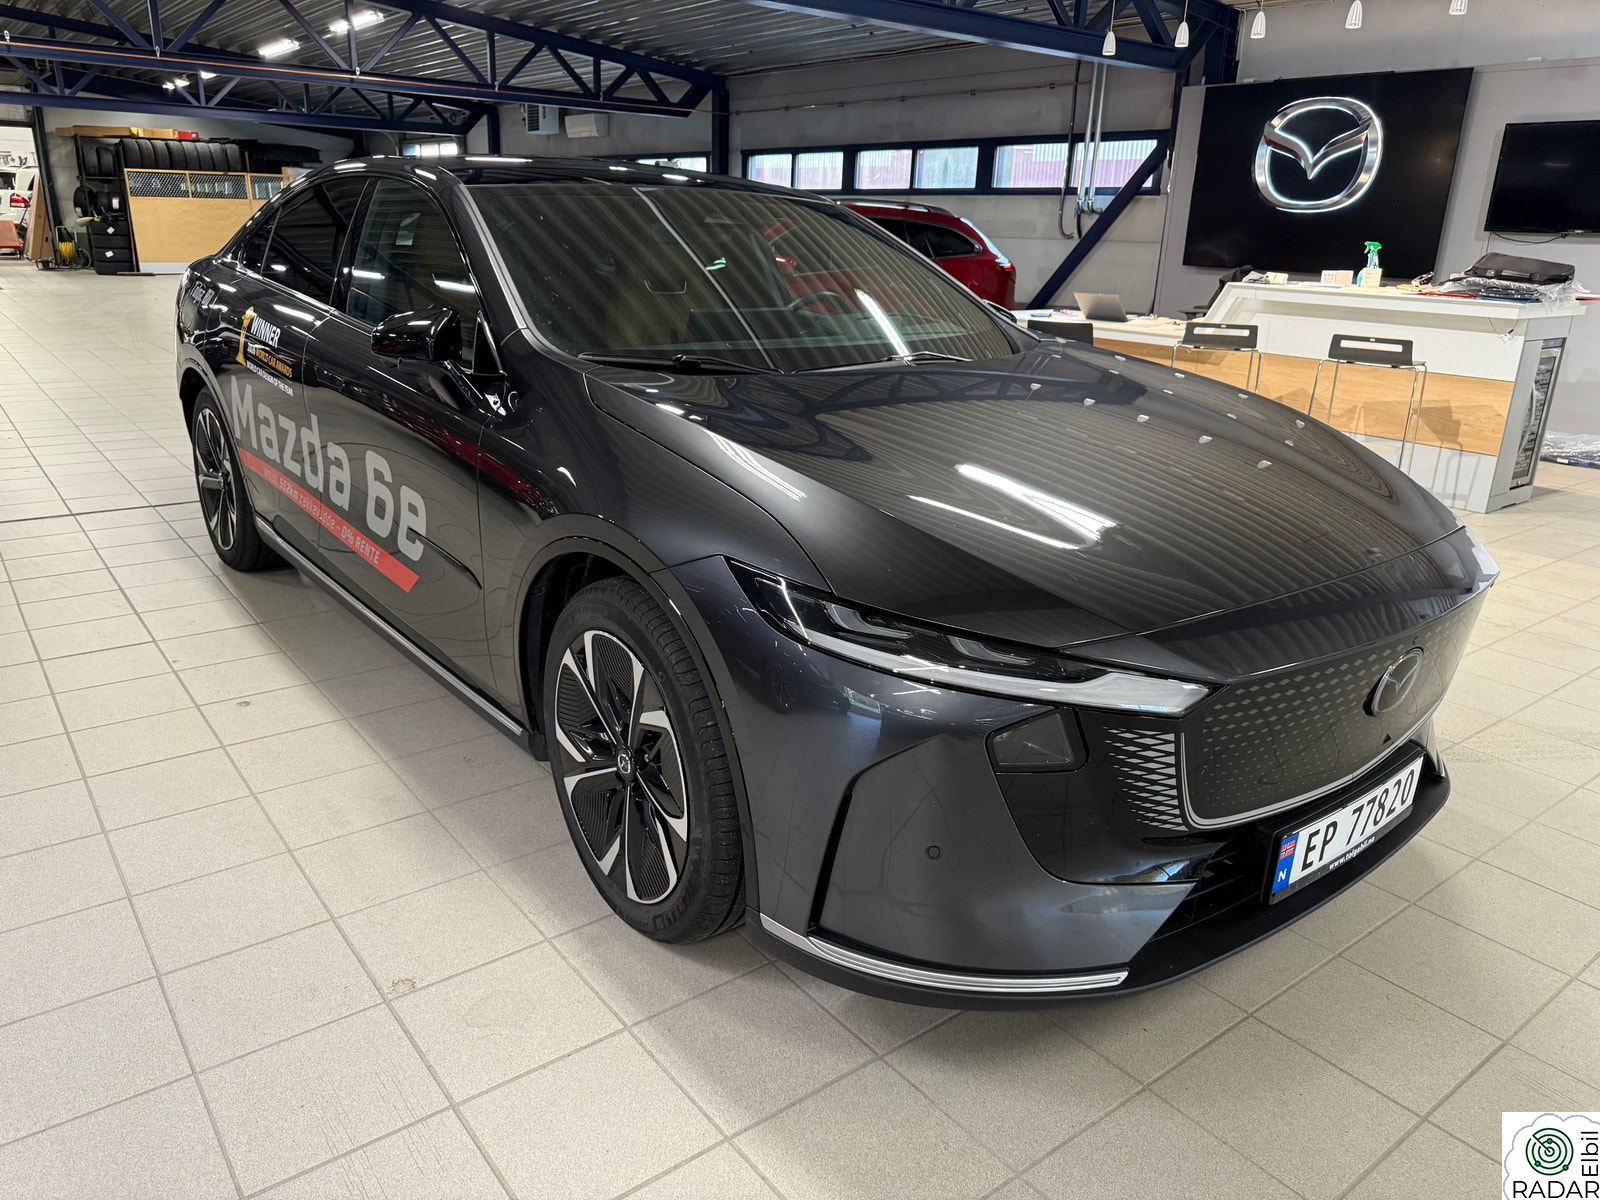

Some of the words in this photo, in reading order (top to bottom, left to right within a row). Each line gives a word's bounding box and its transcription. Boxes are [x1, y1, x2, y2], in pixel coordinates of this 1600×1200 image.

[250, 316, 281, 348] WINNER
[230, 374, 351, 511] Mazda
[365, 450, 427, 561] 6e
[341, 525, 355, 545] 0%
[354, 536, 380, 565] RENTE
[1301, 820, 1338, 873] EP
[1345, 768, 1415, 847] 77820
[1277, 868, 1287, 883] N
